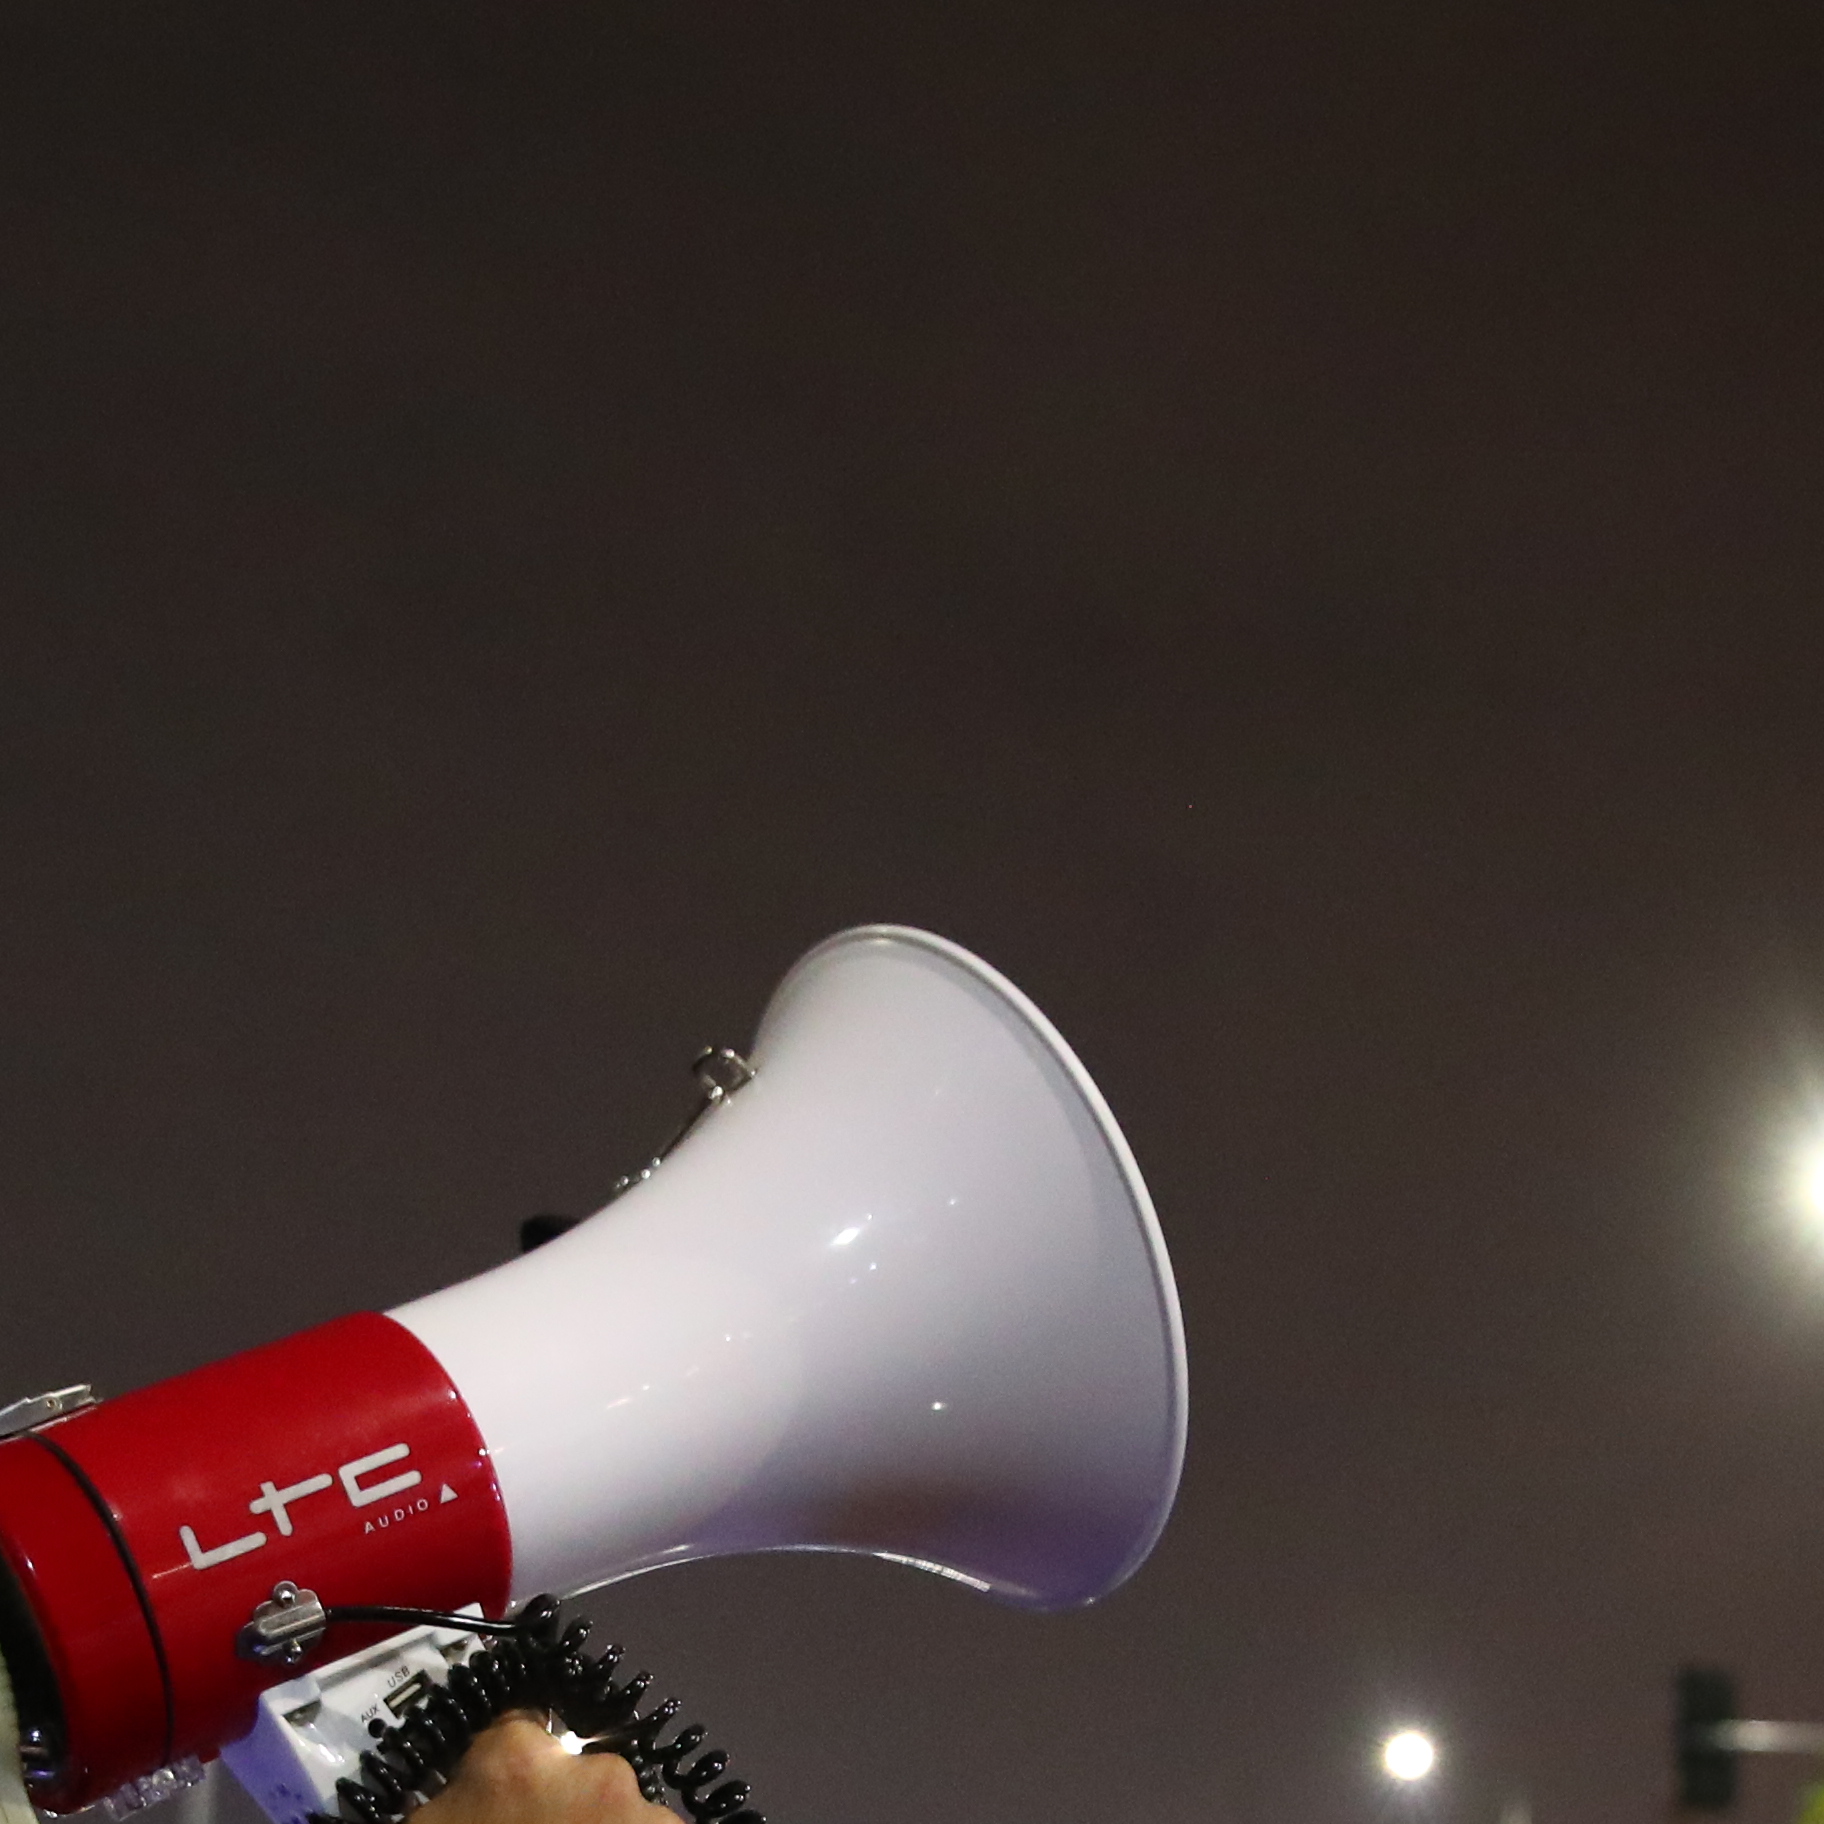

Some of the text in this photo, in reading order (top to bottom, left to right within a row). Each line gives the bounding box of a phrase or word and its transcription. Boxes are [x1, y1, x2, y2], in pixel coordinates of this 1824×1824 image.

[364, 1499, 428, 1534] AUDIO
[387, 1665, 411, 1689] USB
[360, 1705, 381, 1724] AUX
